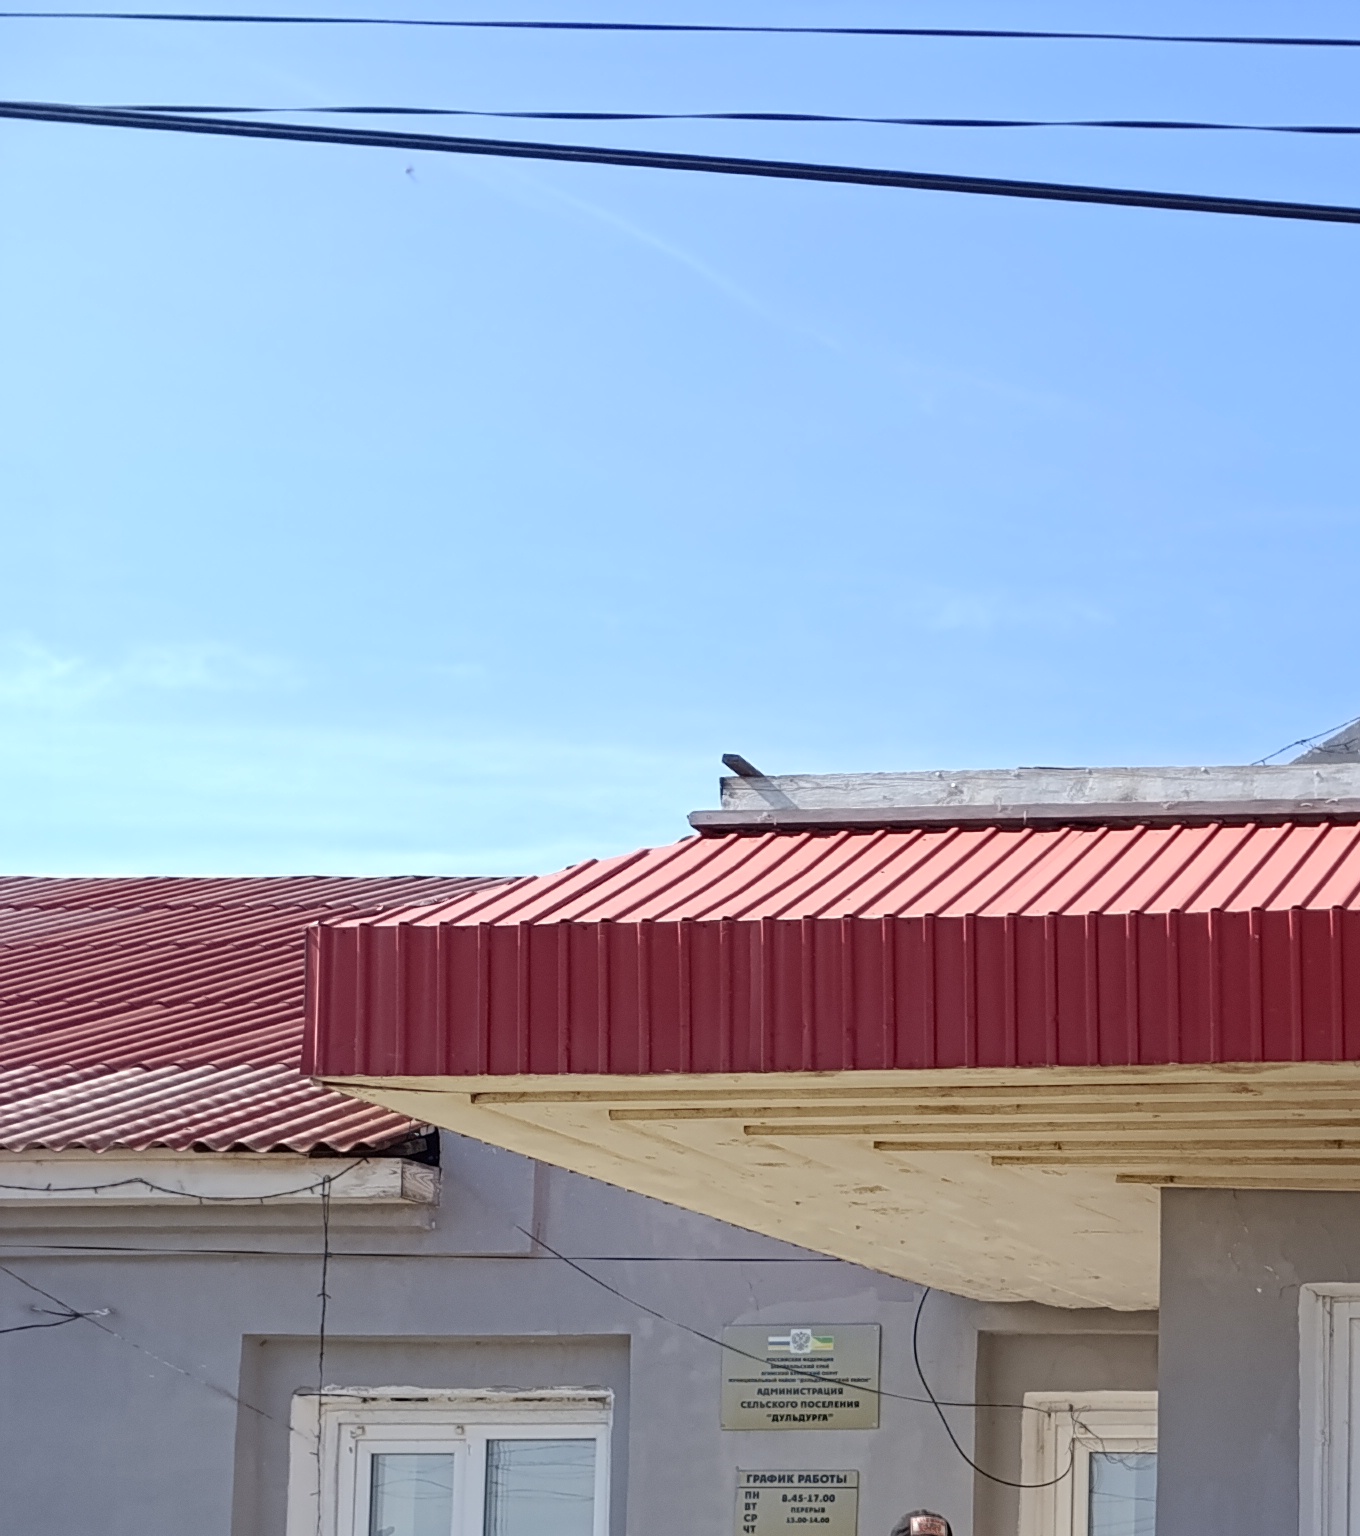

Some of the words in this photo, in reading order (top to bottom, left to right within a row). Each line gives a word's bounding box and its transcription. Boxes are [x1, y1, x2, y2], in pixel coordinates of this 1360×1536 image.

[757, 1387, 844, 1396] АДМИНИСТРАЦИЯ
[740, 1400, 798, 1409] СЕЛЬСКОГО
[800, 1400, 860, 1409] ПОСЕЛЕНИЯ
[746, 1474, 795, 1484] ГРАФИК
[797, 1474, 847, 1484] РАБОТЫ
[744, 1491, 760, 1500] ПН
[744, 1502, 757, 1511] ВТ
[743, 1514, 758, 1522] СР
[743, 1525, 756, 1534] ЧТ
